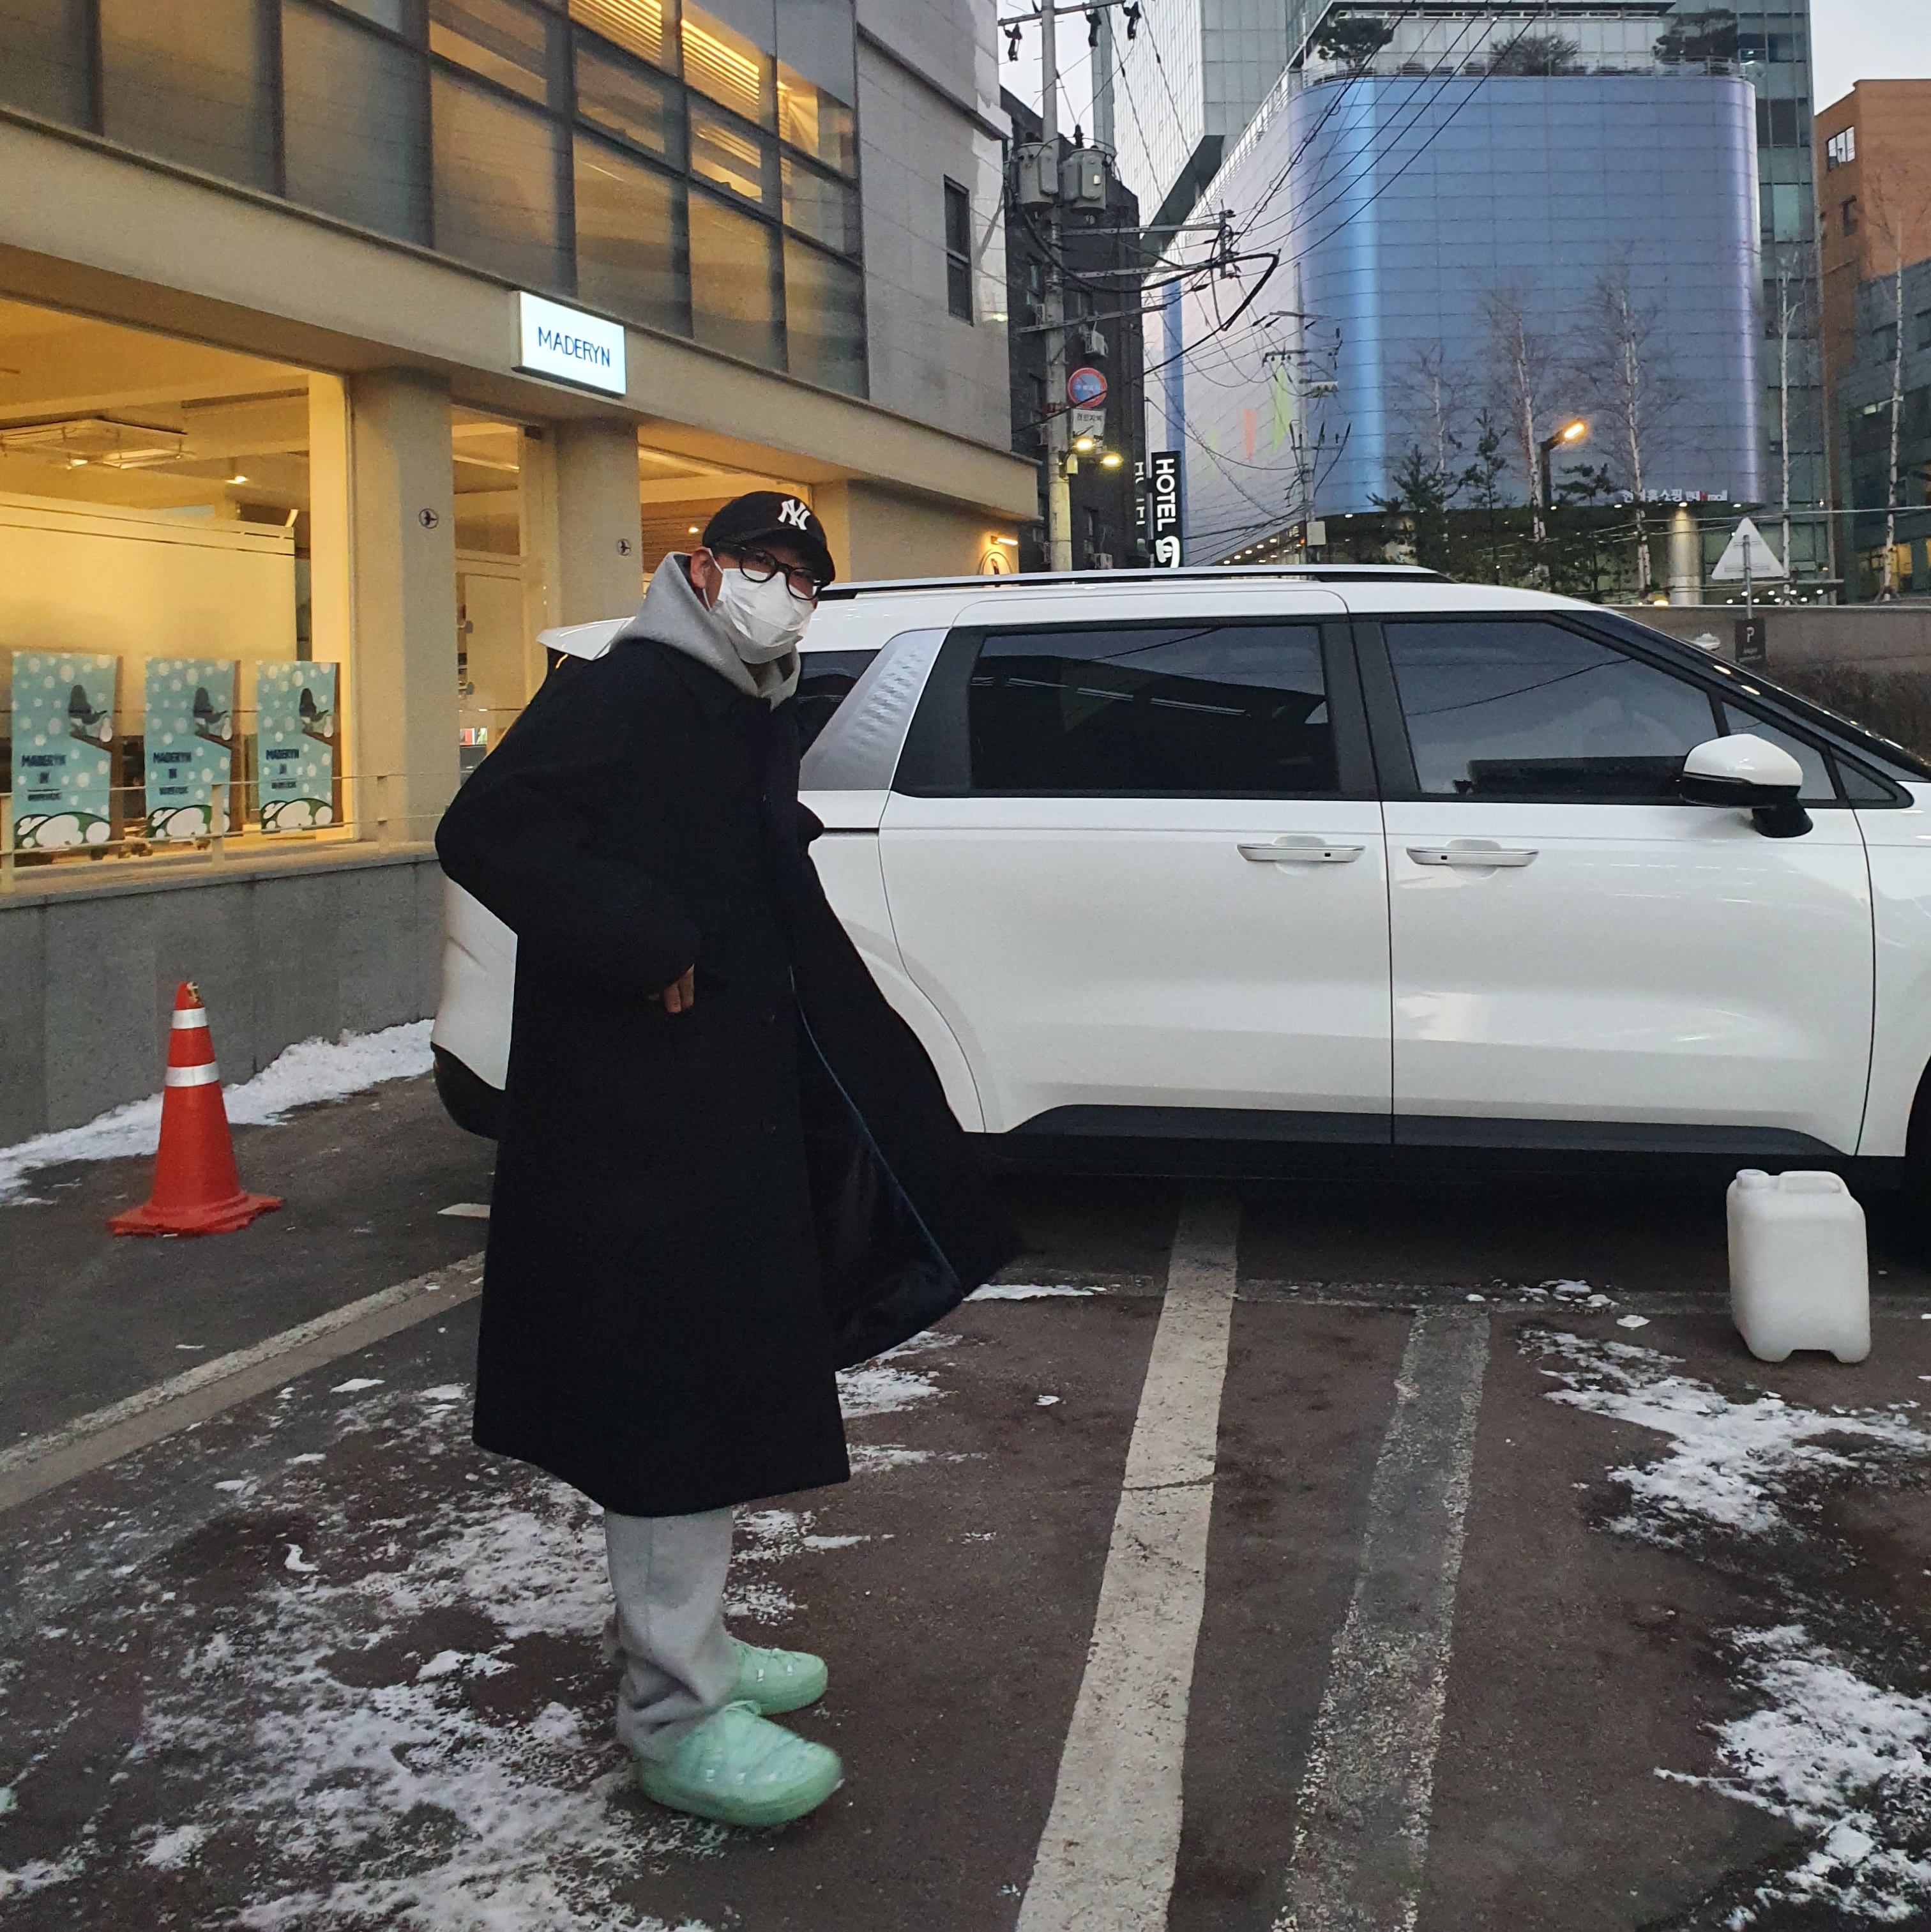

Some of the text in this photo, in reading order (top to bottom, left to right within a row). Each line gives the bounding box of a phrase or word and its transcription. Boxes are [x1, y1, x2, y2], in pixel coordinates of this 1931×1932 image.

[538, 326, 610, 367] MADERYN
[778, 499, 811, 530] NY
[1156, 459, 1176, 531] HOTEL
